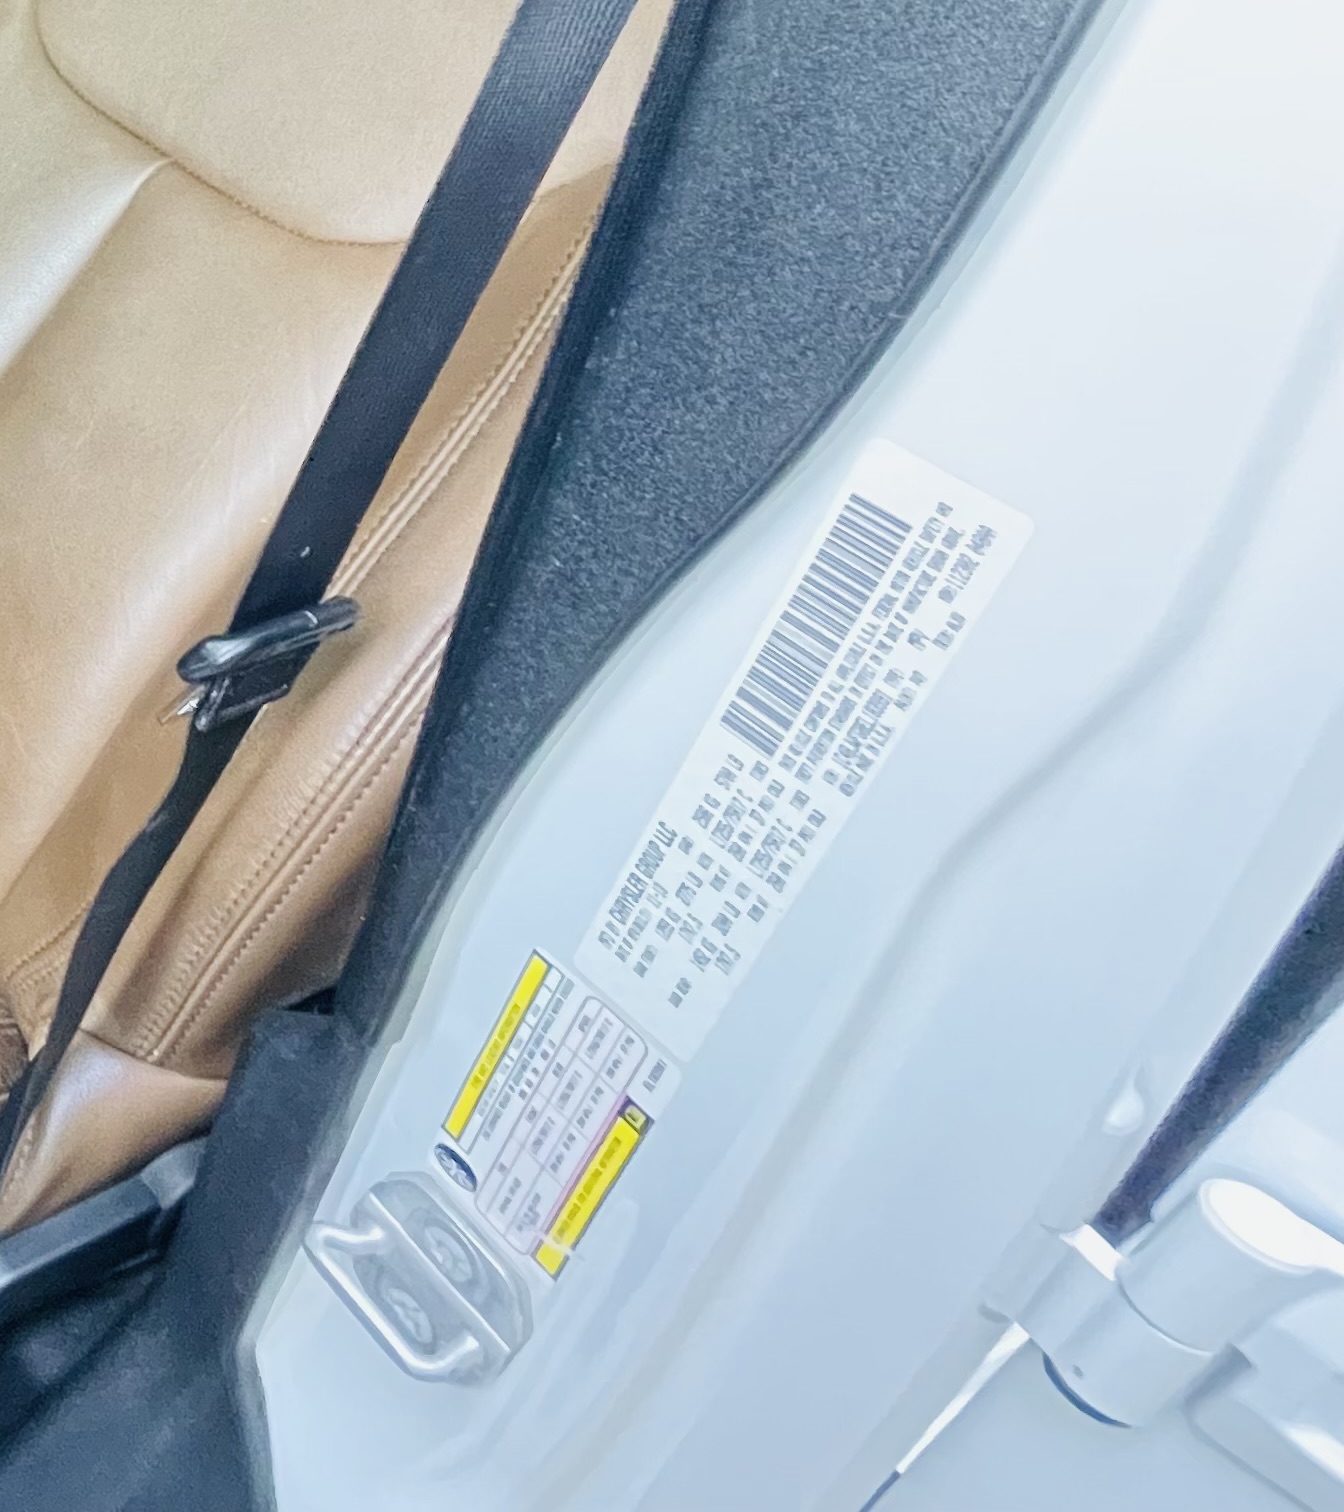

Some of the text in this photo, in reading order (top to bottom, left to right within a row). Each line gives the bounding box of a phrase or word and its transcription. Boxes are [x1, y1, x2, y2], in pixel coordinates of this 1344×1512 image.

[609, 872, 649, 925] CHRYSLER
[635, 840, 666, 879] GROUP
[653, 821, 678, 848] LLC
